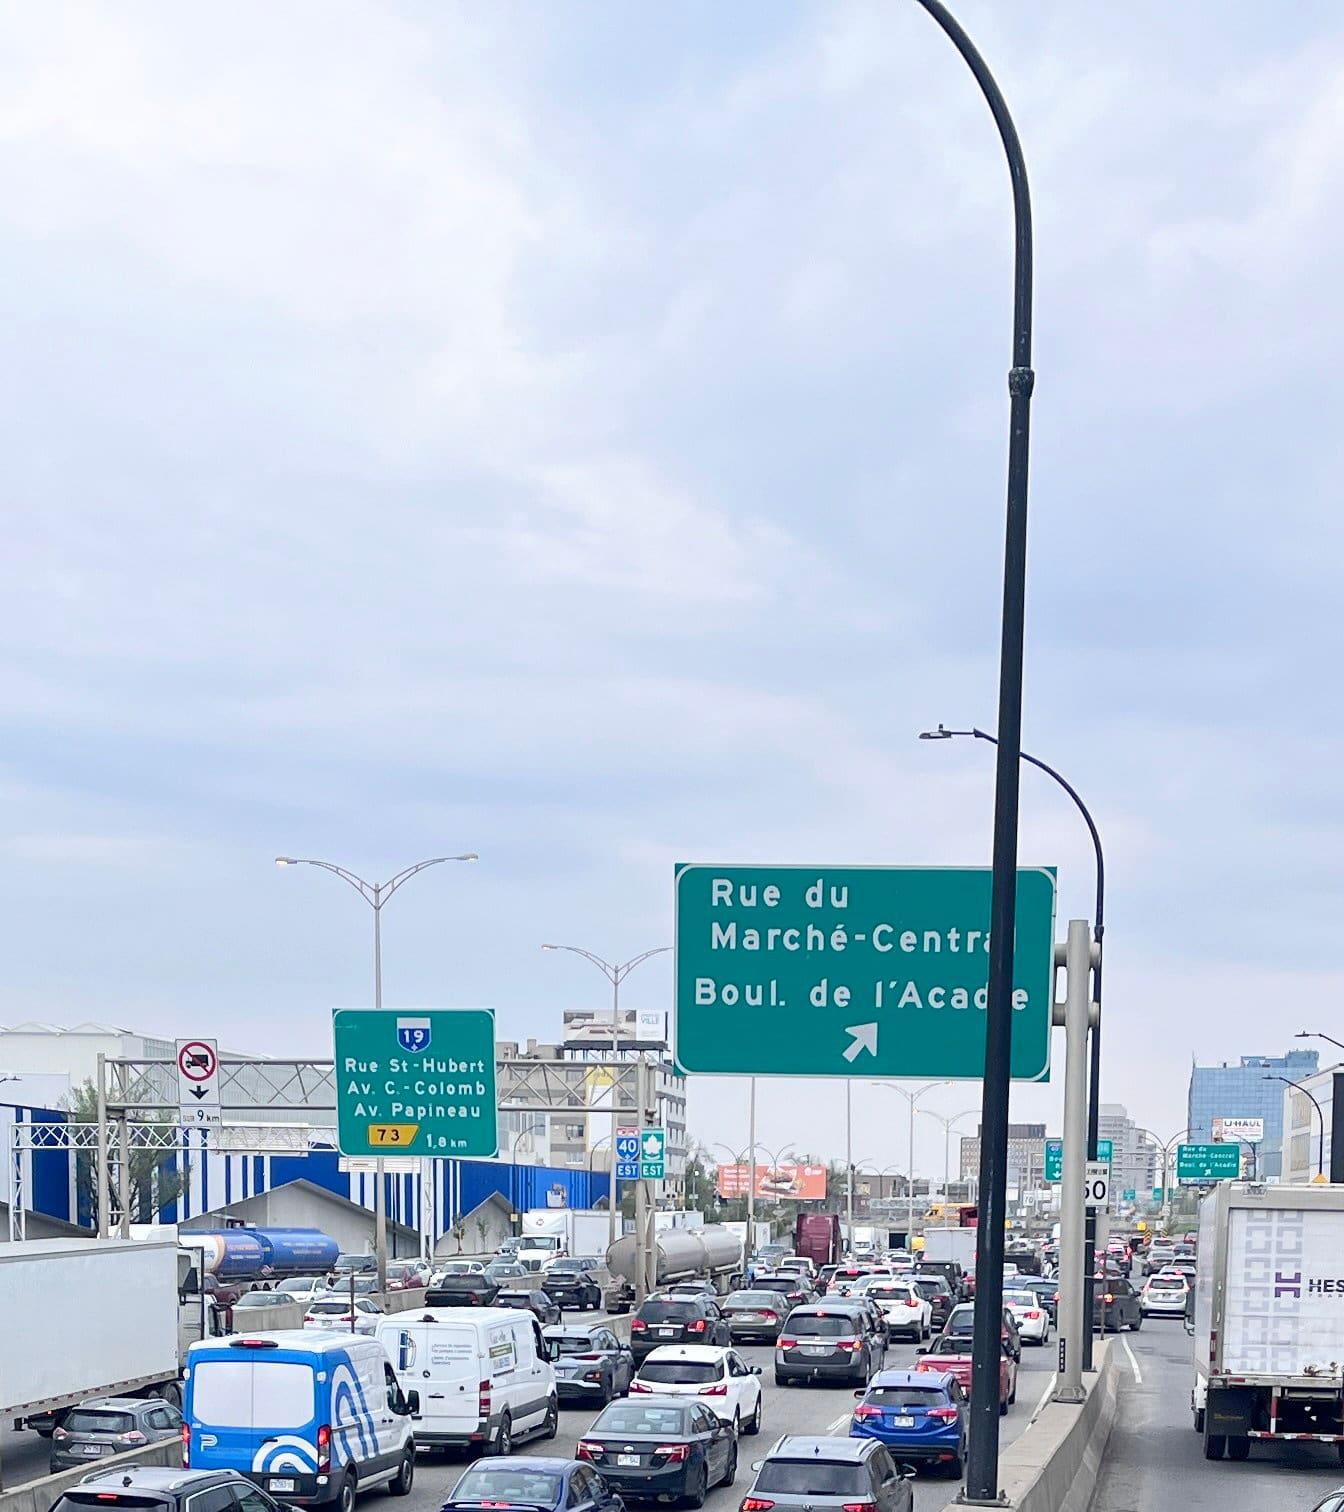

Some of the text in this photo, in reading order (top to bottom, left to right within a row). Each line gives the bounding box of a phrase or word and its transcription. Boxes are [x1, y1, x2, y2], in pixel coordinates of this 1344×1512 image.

[712, 878, 849, 908] Rue du
[711, 922, 1016, 954] Marché-Centr
[695, 978, 1029, 1011] Boul. de l'Acade
[404, 1029, 424, 1043] 19
[345, 1058, 379, 1073] Rue
[347, 1081, 375, 1095] Av.
[197, 1109, 204, 1121] 9
[354, 1102, 481, 1120] Av. Papineau
[376, 1128, 400, 1142] 73
[426, 1133, 467, 1149] 1,8 km
[618, 1139, 637, 1153] 40
[617, 1164, 638, 1176] EST
[642, 1164, 663, 1176] EST
